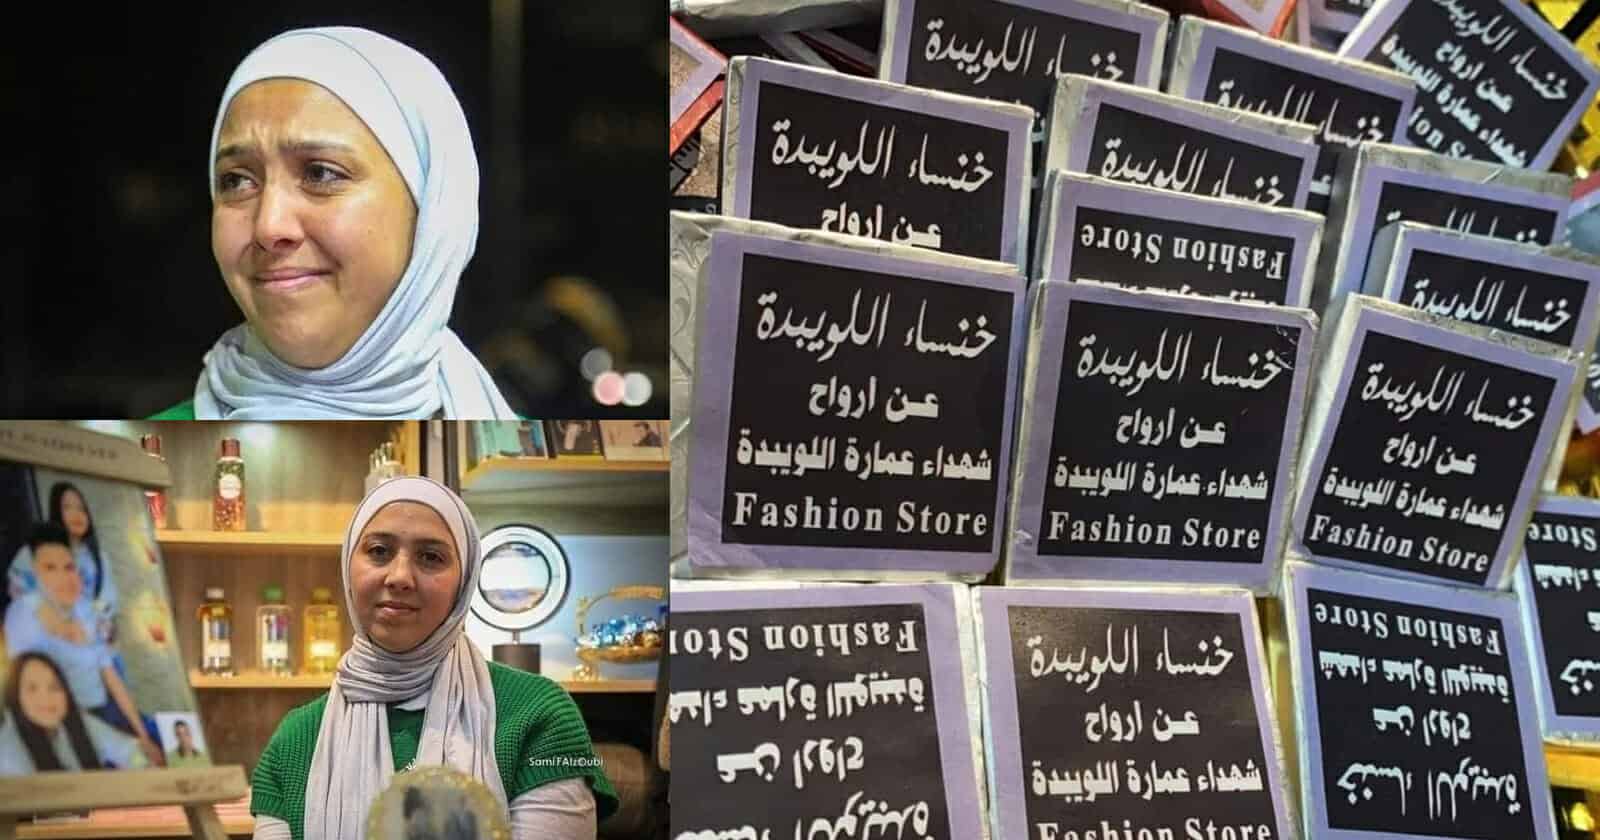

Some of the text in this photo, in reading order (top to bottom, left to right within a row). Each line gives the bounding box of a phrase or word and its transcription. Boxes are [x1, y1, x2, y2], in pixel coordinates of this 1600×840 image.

[924, 18, 1039, 85] اللويبدة
[1435, 41, 1485, 81] ارواح
[1509, 46, 1568, 99] خنساء
[1475, 78, 1513, 113] عن
[771, 119, 994, 193] خنساء اللويبدة
[891, 216, 942, 249] عن
[1080, 223, 1286, 280] Fashion Store
[756, 288, 997, 362] خنساء اللويبدة
[1505, 284, 1572, 333] خنساء
[1076, 328, 1283, 397] خنساء اللويبدة
[808, 375, 940, 422] عن ارواح
[1361, 362, 1536, 430] خنساء اللويبدة
[1115, 407, 1227, 448] عن ارواح
[1382, 432, 1478, 475] عن ارواح
[736, 428, 993, 481] شهداء عمارة اللويبدة
[1053, 455, 1269, 500] شهداء عمارة اللويبدة
[731, 490, 988, 536] Fashion Store
[1322, 467, 1506, 531] شهداء عمارة اللويبدة
[1047, 510, 1261, 549] Fashion Store
[1308, 513, 1490, 572] Fashion Store
[1528, 522, 1597, 552] Store
[670, 619, 920, 662] Fashion Sto
[1314, 603, 1501, 656] Fashion Store
[1027, 623, 1234, 693] خنساء اللويبدة
[1319, 650, 1510, 703] شهداء عمارة اللويبدة
[670, 671, 925, 727] هداء عمارة اللويبدة
[1084, 700, 1200, 742] عن ارواح
[1372, 705, 1472, 747] عن ارواح
[716, 736, 865, 789] عن ارواح
[1031, 759, 1264, 803] شهداء عمارة اللويبدة
[1337, 757, 1521, 822] خنساء اللويبدة
